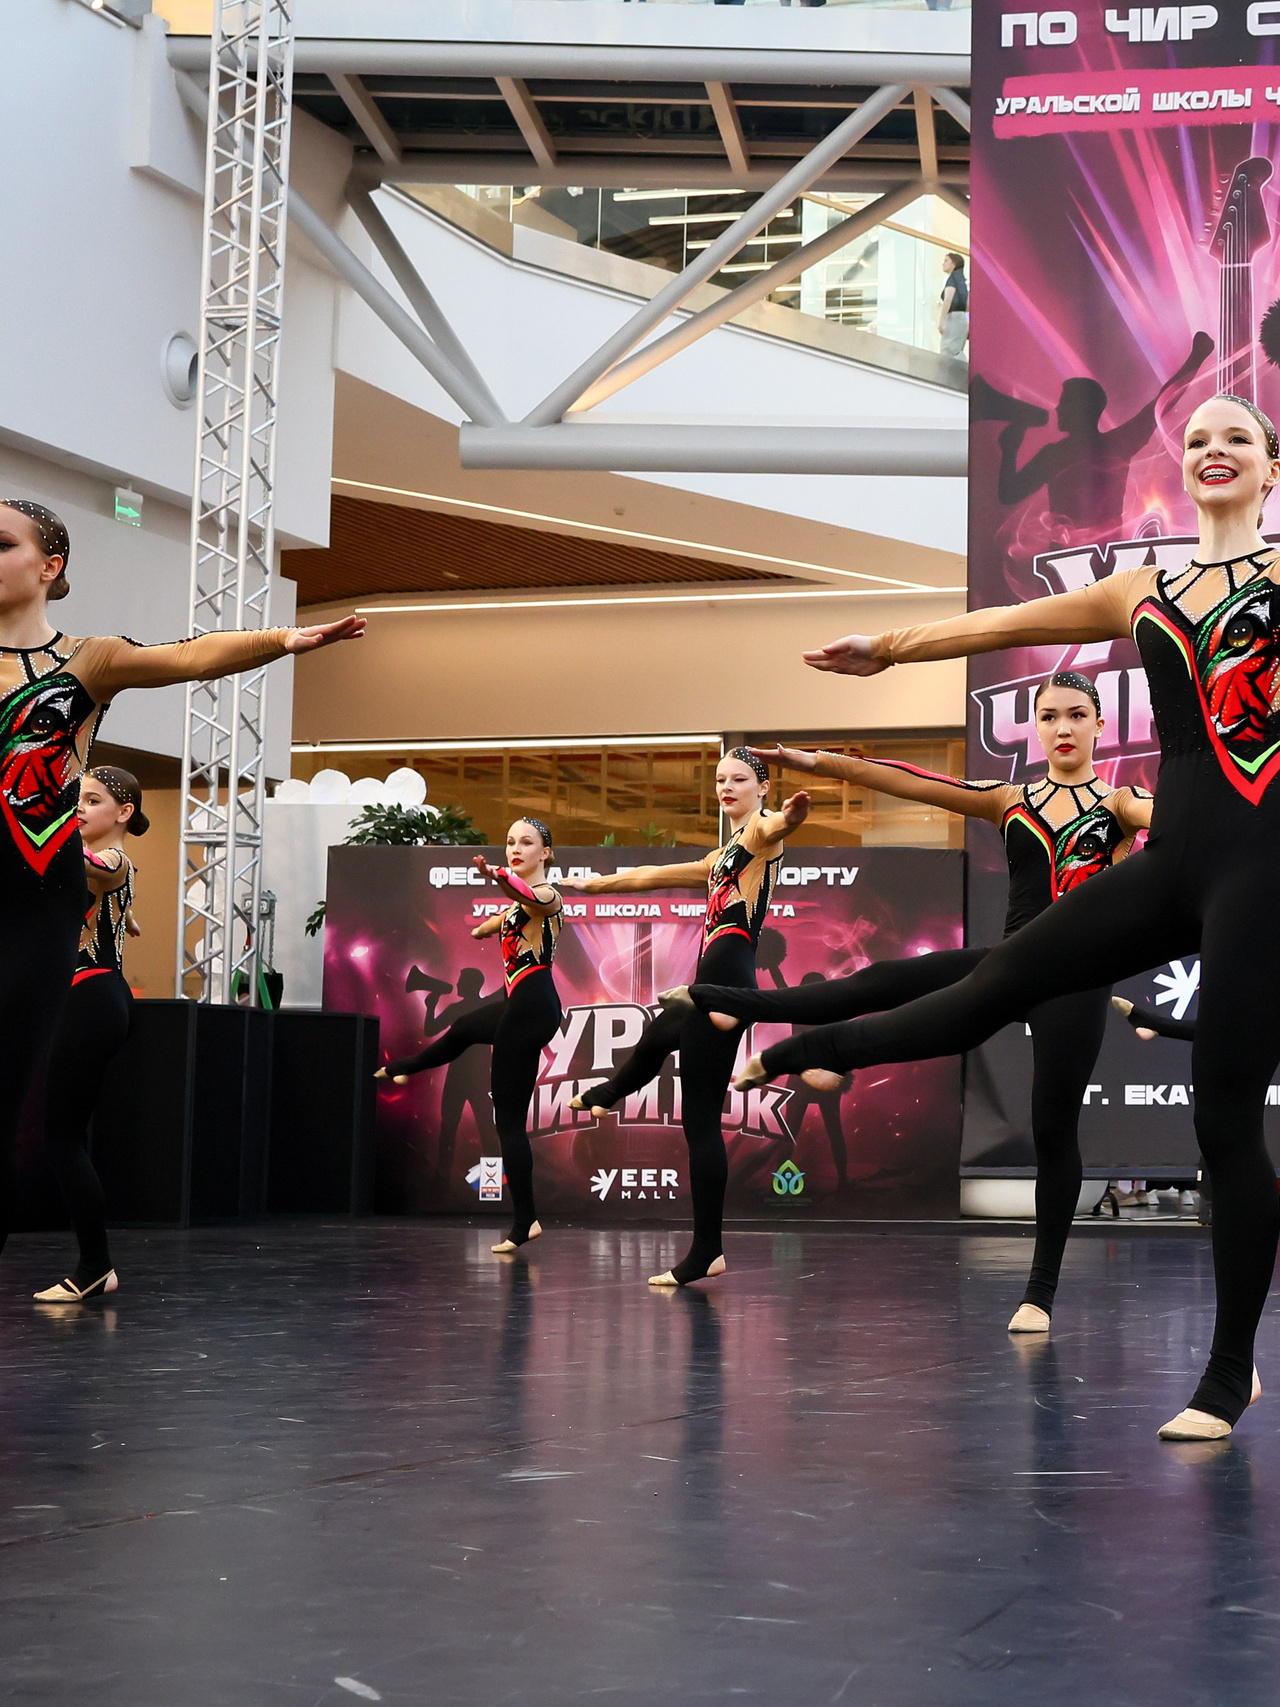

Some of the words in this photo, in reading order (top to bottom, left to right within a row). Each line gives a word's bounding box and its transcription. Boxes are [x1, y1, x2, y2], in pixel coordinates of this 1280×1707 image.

[1001, 11, 1077, 47] ПО
[1105, 5, 1218, 42] ЧИР
[995, 87, 1141, 115] УРАЛЬСКОЙ
[1152, 88, 1252, 112] ШКОЛЫ
[429, 866, 602, 889] ФЕСАЛЬ
[595, 904, 662, 917] ШКОЛА
[670, 904, 707, 917] ЧИР
[589, 1168, 680, 1202] YEER
[621, 1190, 676, 1200] MALL
